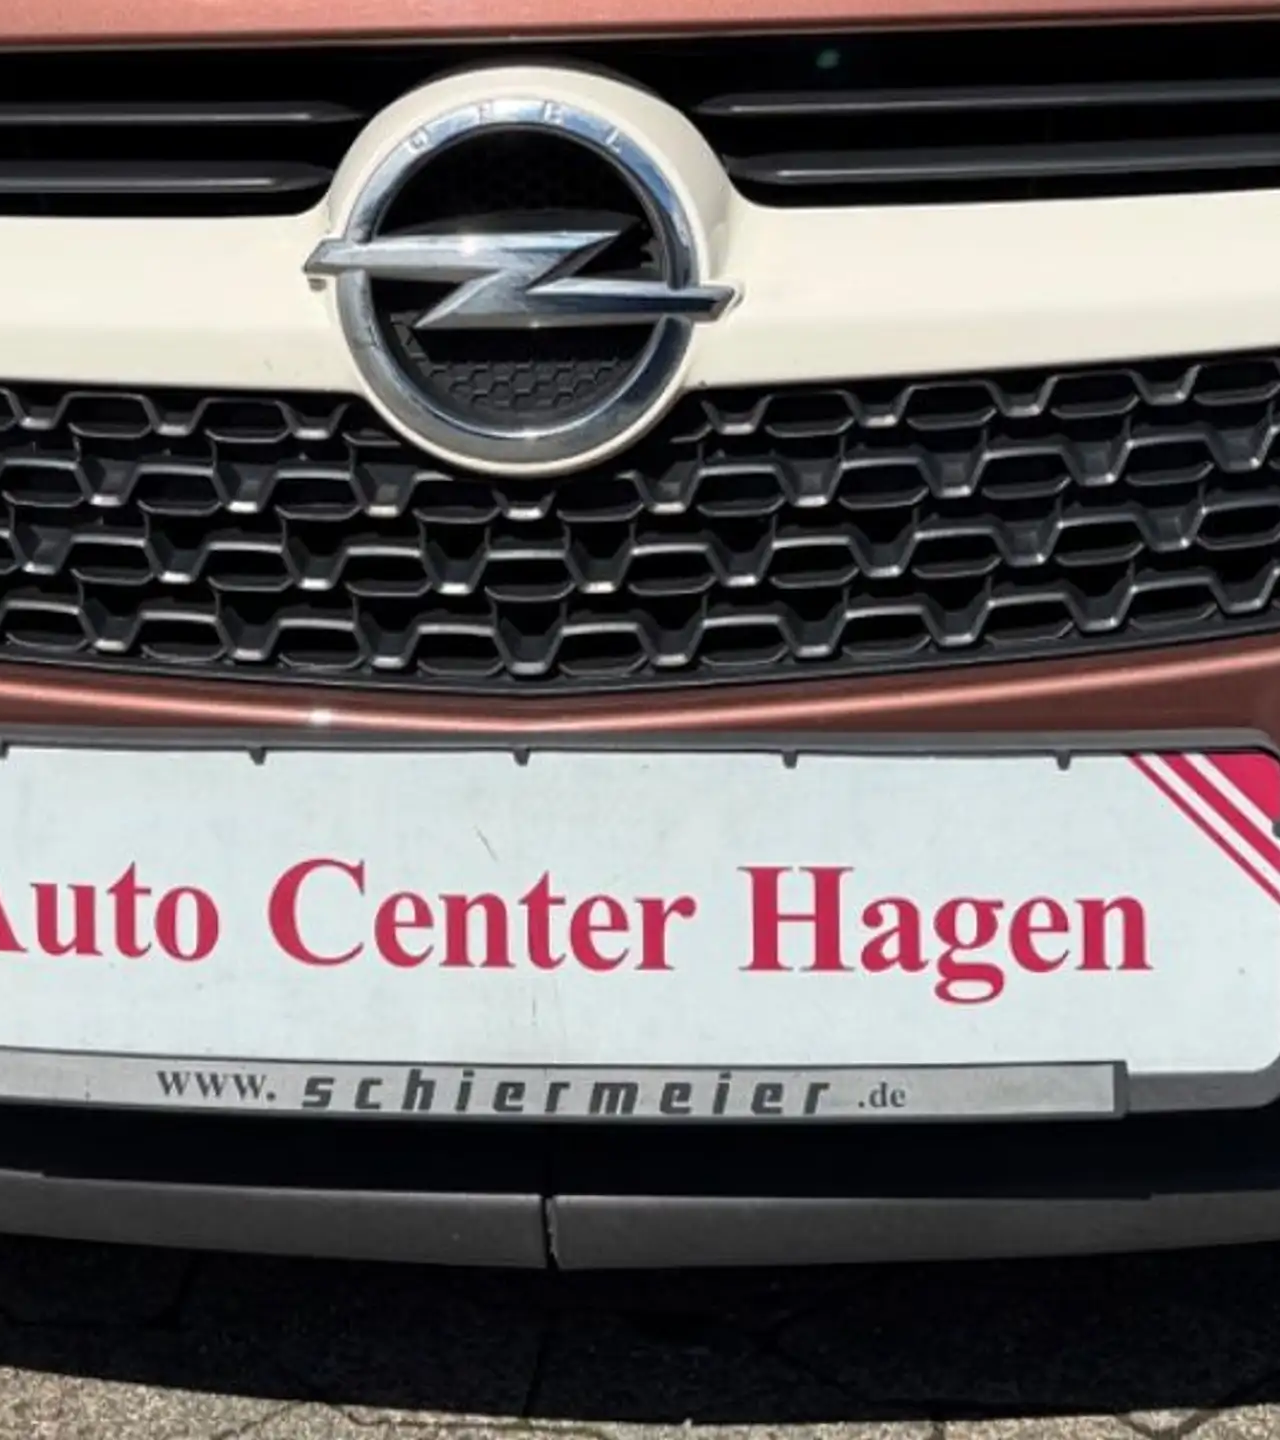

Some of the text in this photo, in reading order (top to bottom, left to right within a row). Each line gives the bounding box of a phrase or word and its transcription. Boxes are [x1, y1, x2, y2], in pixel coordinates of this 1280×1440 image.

[406, 100, 622, 154] OPEL
[266, 856, 698, 972] Center
[736, 865, 1154, 1005] Hagen
